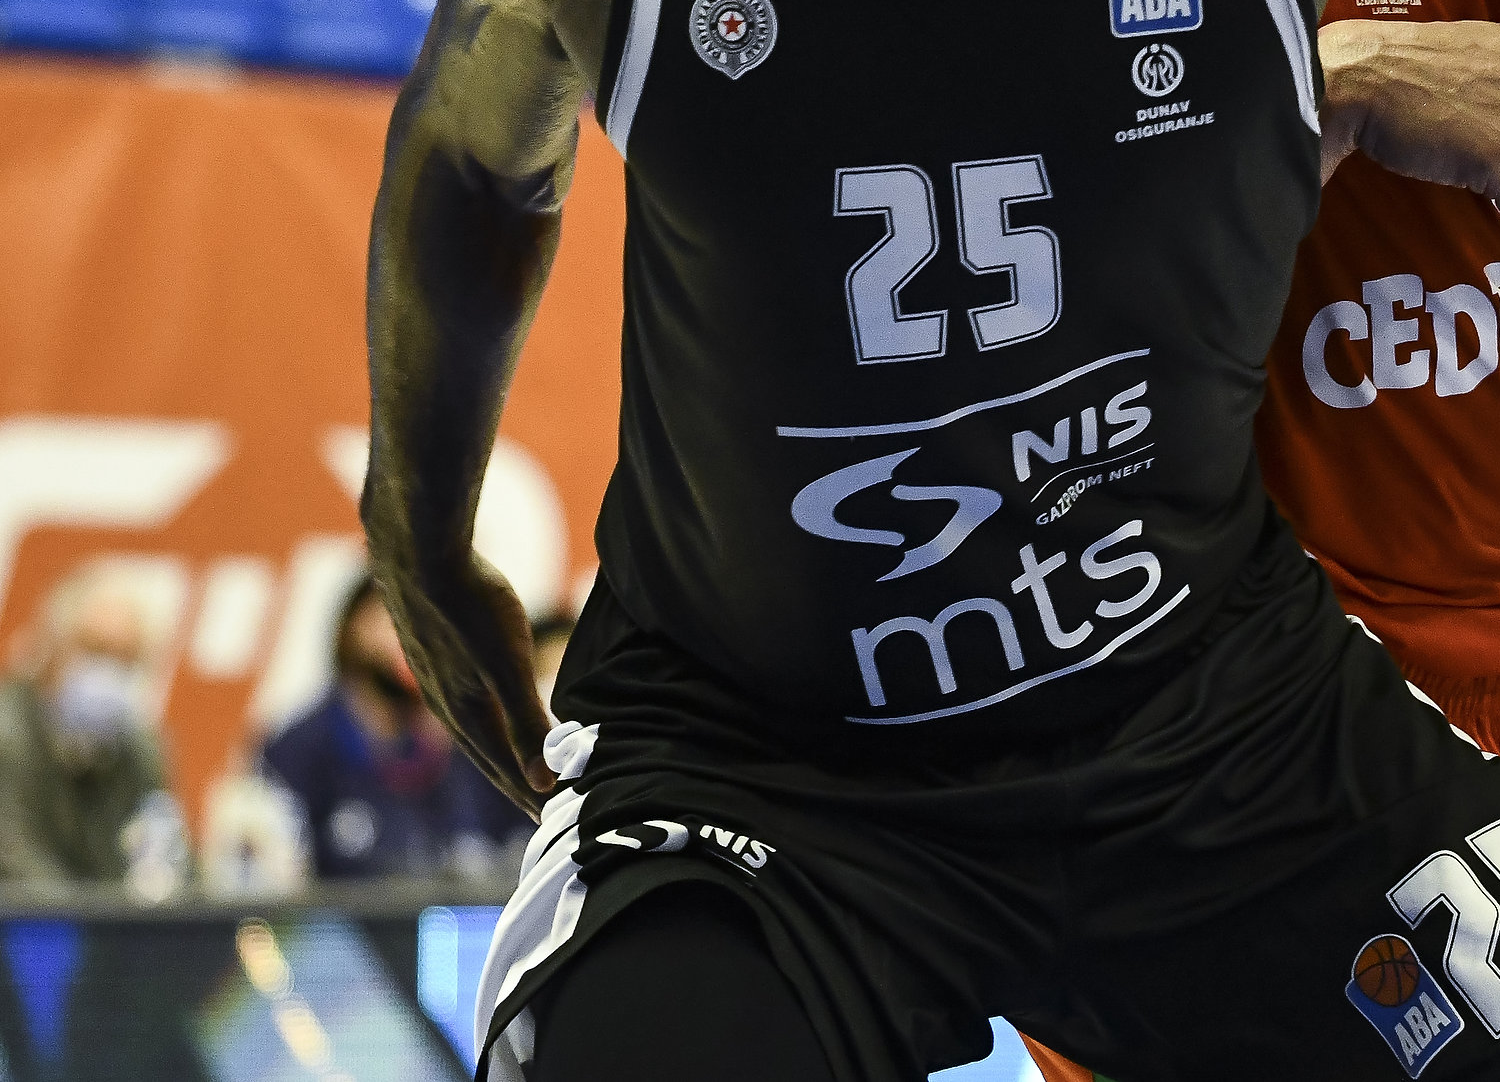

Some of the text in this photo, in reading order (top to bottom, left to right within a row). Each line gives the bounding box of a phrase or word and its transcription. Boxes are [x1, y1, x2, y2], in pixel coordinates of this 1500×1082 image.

[1113, 111, 1216, 144] OSIGURANJE
[1136, 99, 1191, 123] DUNAV
[832, 154, 1063, 365] 25
[1011, 380, 1153, 483] NIS
[1034, 457, 1156, 526] GAZPROM NEFT
[850, 519, 1163, 708] mts
[699, 824, 777, 869] NIS
[1394, 991, 1452, 1067] ABA
